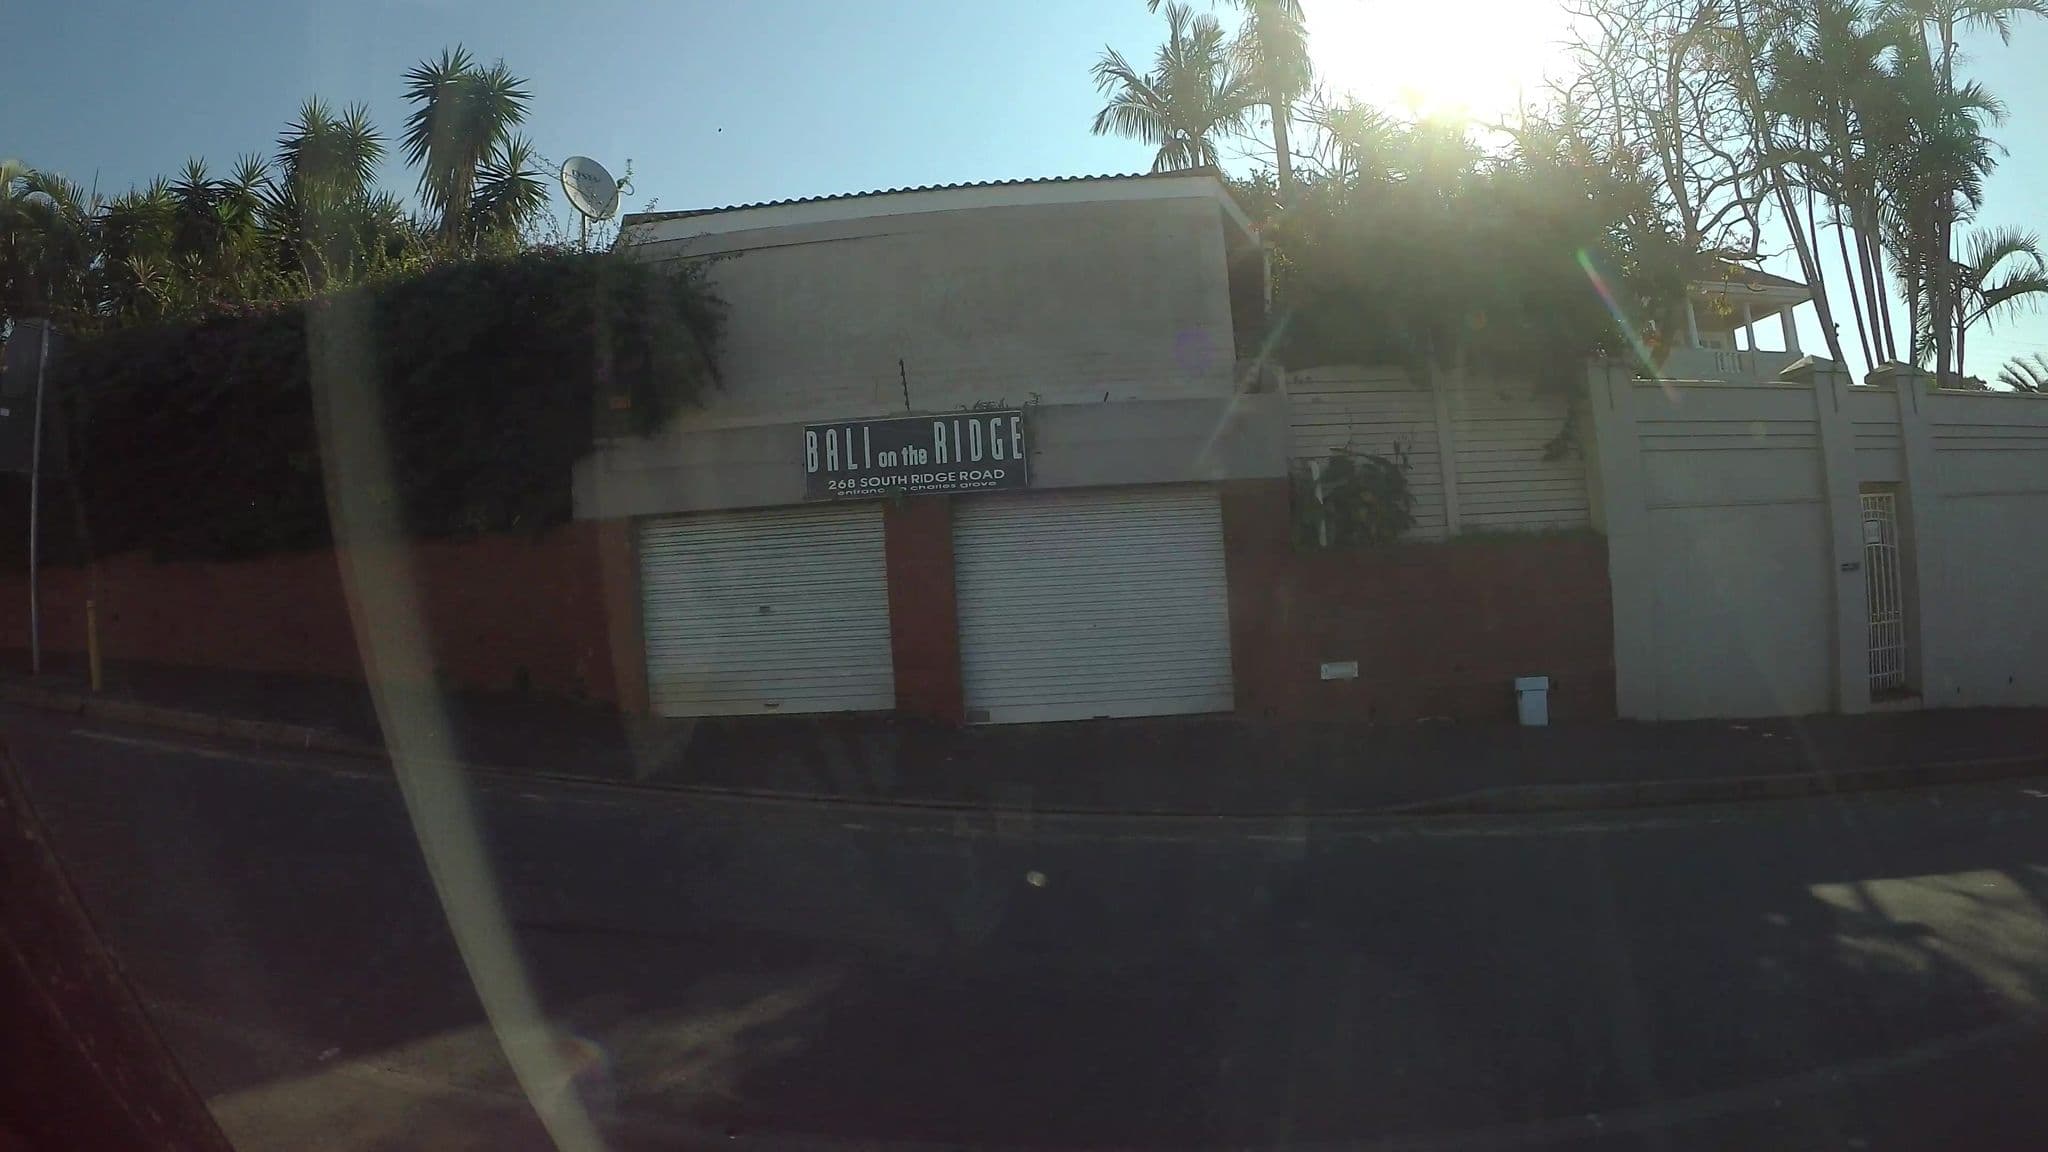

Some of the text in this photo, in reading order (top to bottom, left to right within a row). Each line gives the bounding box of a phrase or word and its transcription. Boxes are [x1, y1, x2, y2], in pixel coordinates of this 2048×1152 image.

[805, 416, 1023, 473] BALI on the RIDGE
[828, 469, 1005, 490] 268 SOUTH RIDGE ROAD
[837, 488, 889, 496] entranc
